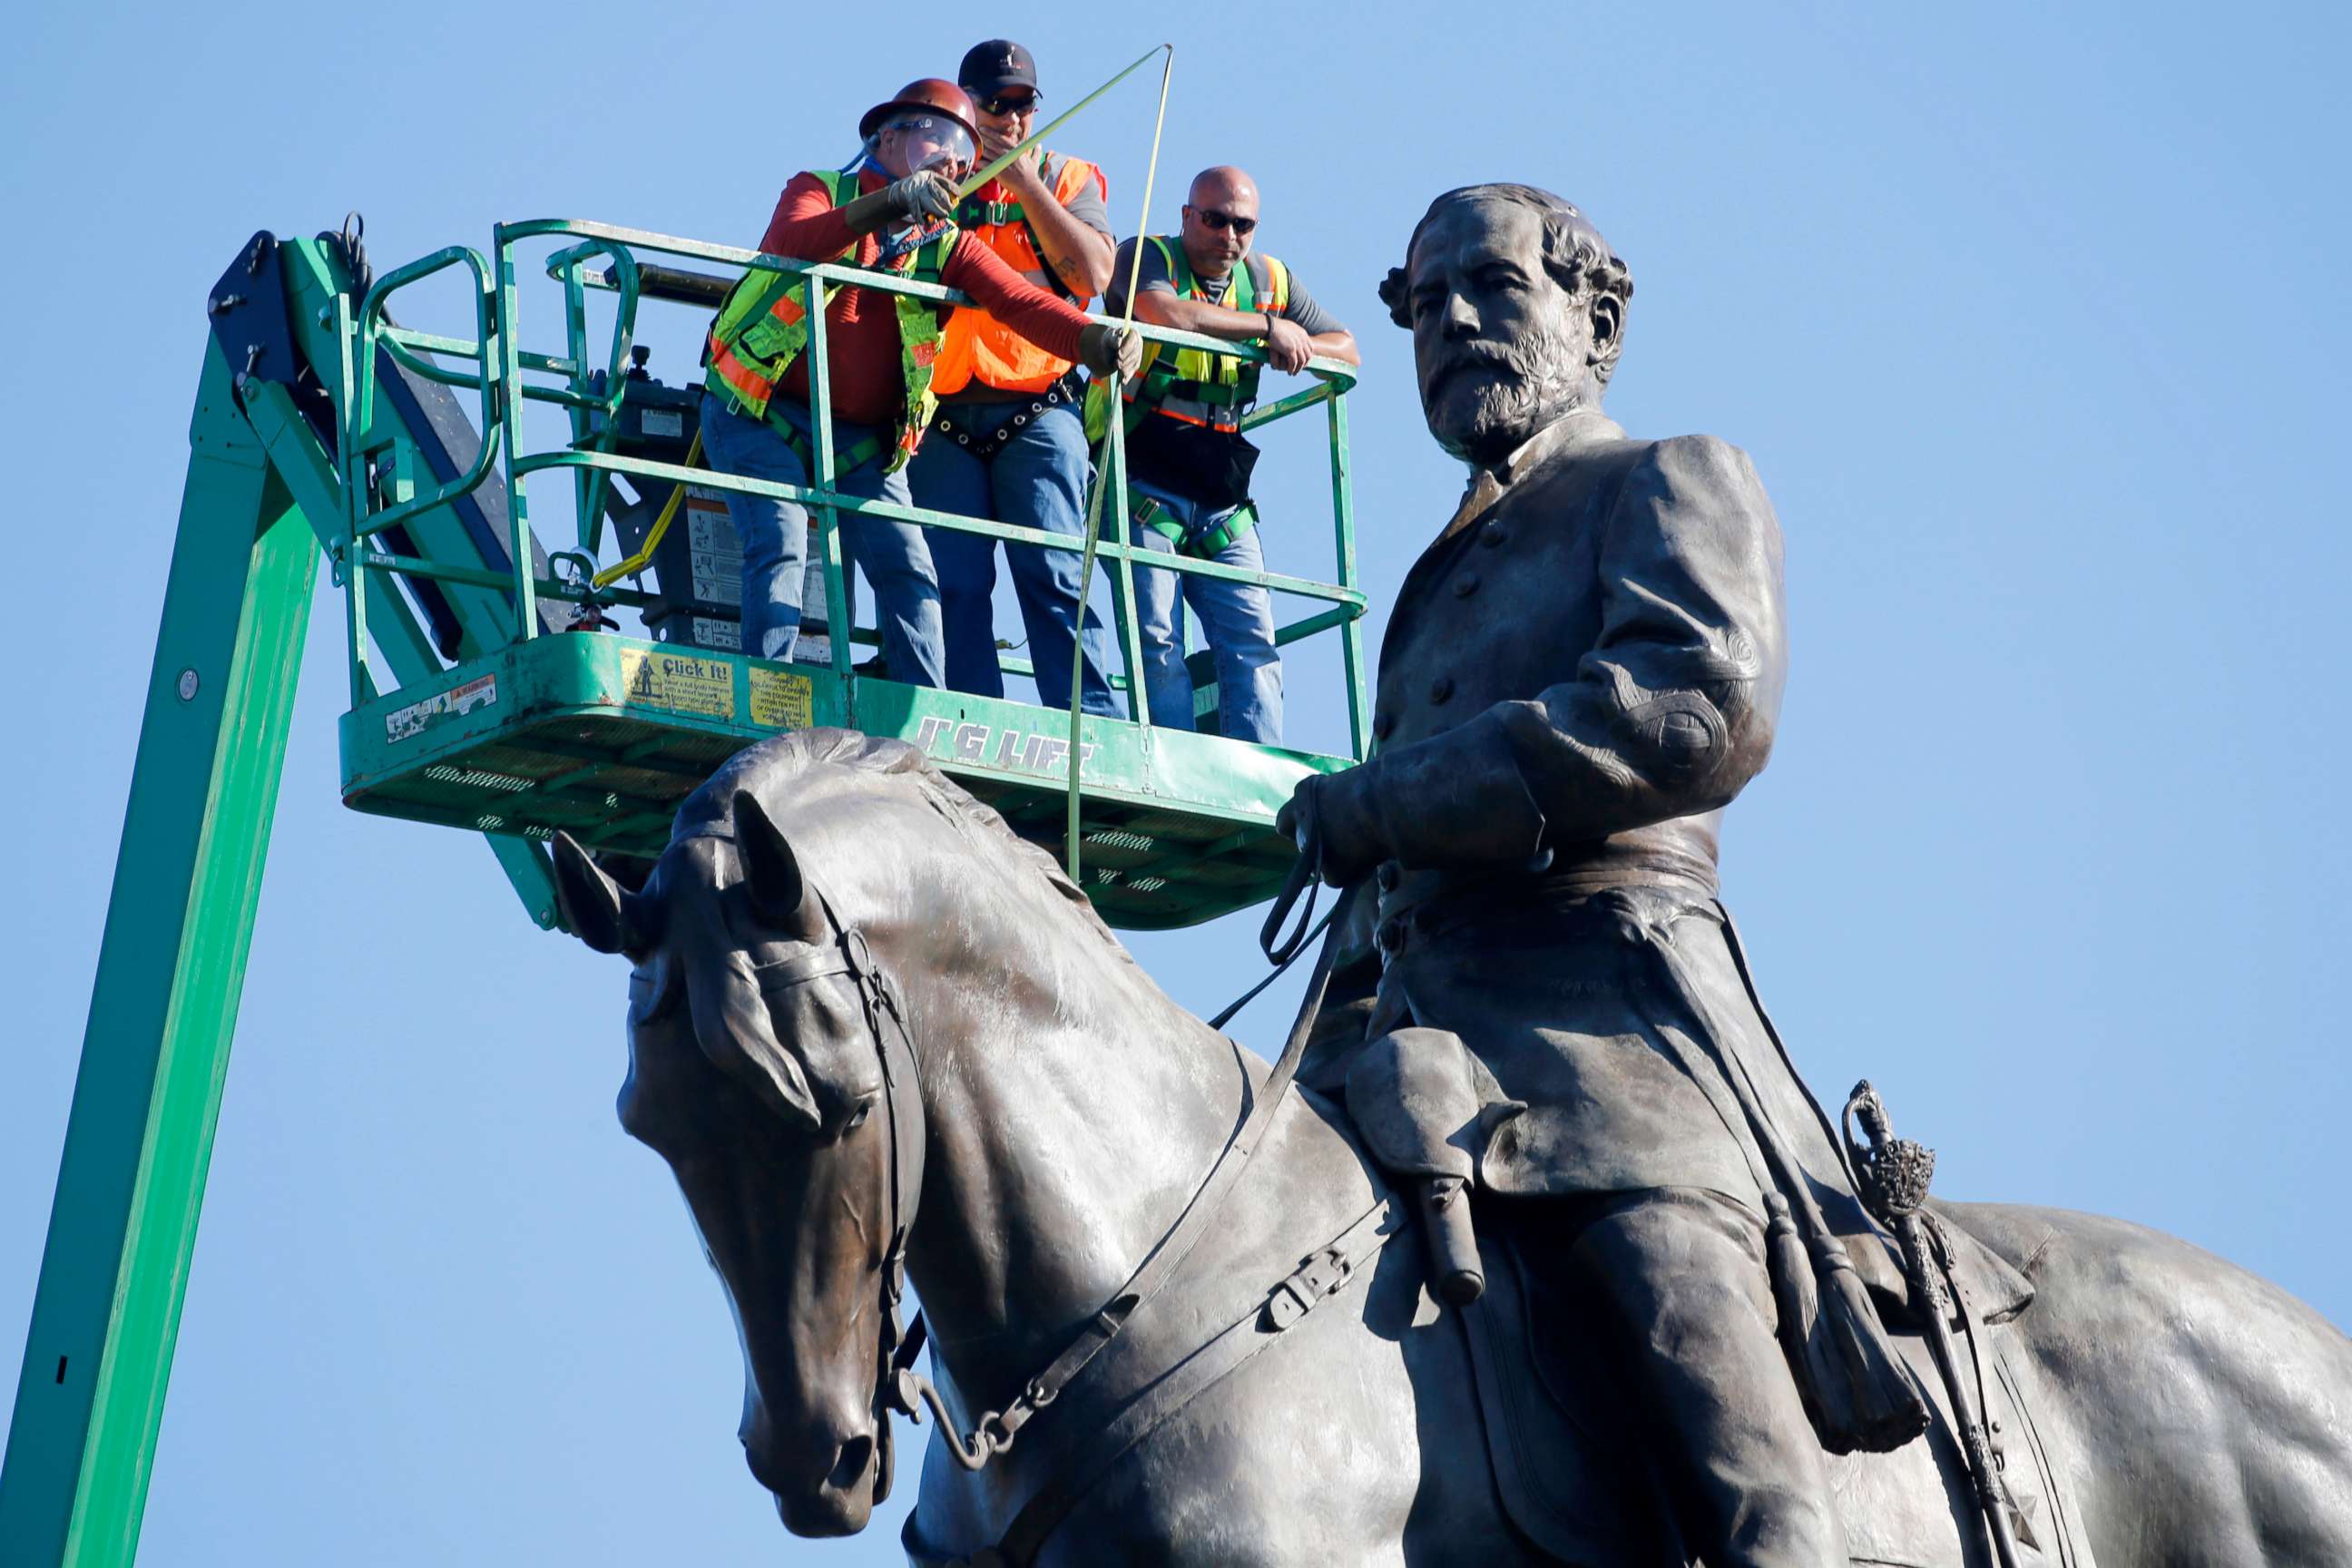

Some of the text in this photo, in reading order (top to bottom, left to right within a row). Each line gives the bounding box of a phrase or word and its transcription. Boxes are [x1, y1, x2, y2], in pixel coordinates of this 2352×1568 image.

[662, 658, 727, 681] Click It!
[996, 729, 1094, 778] LIFT
